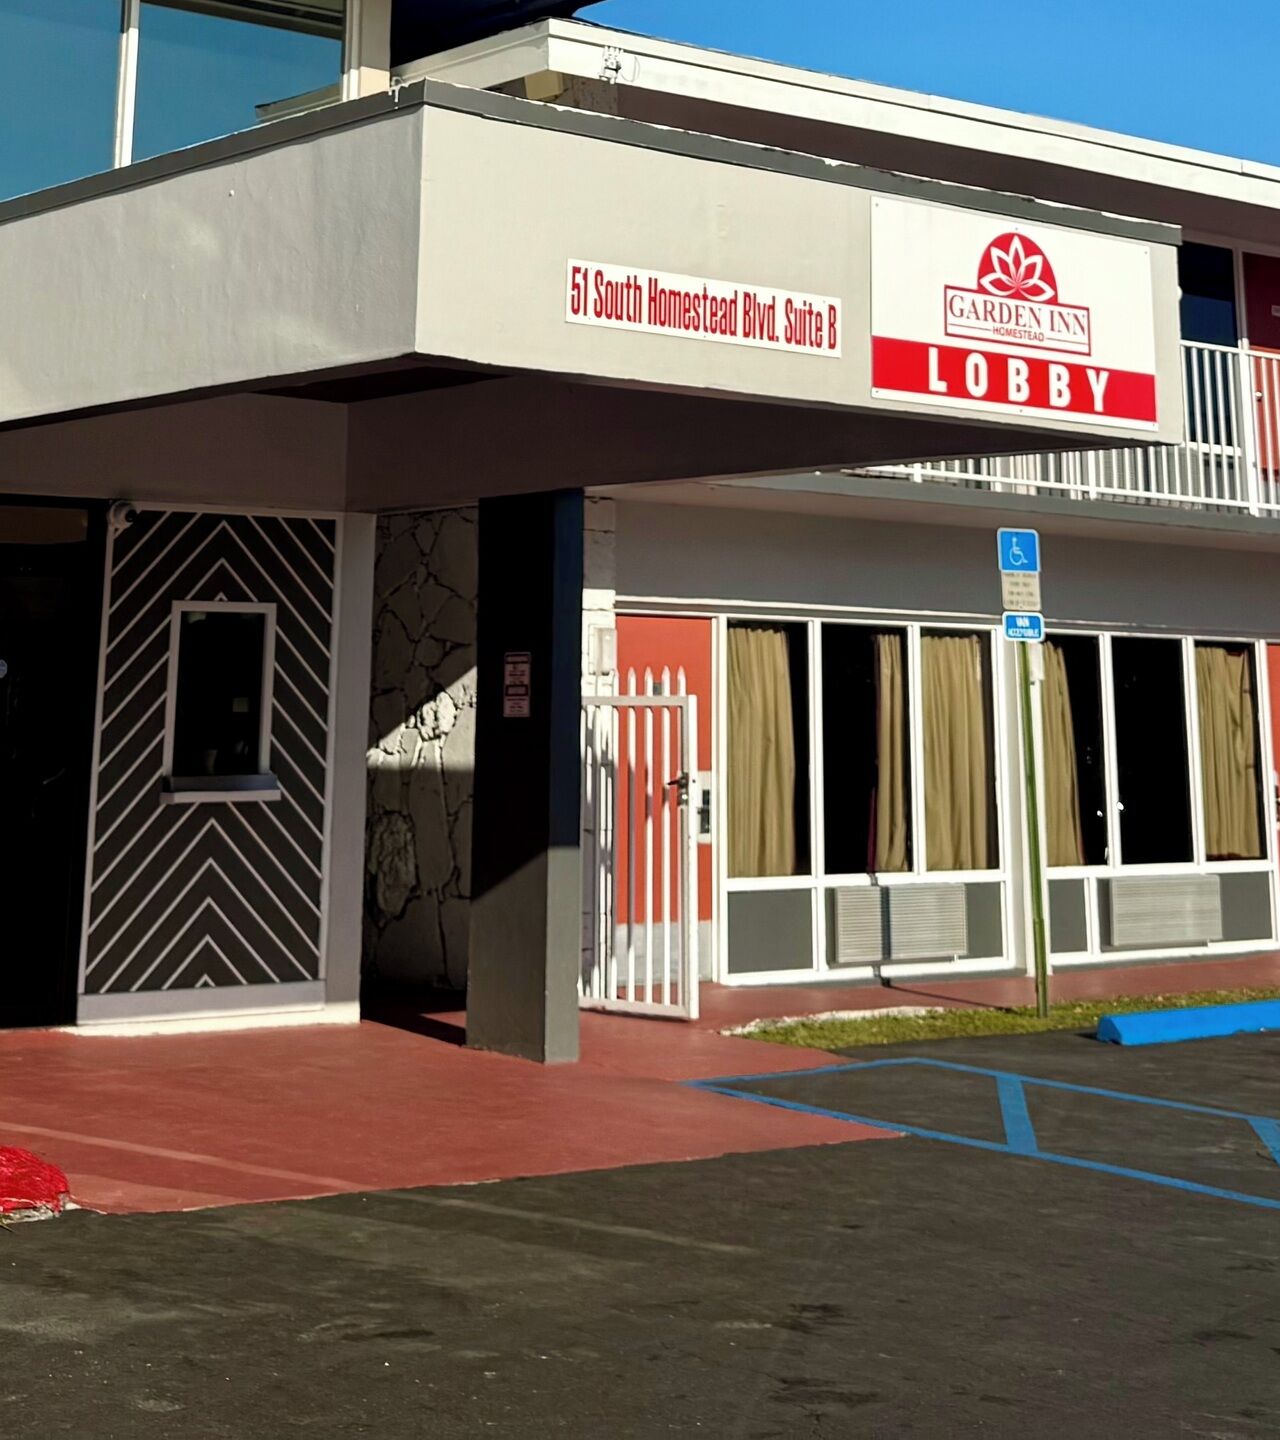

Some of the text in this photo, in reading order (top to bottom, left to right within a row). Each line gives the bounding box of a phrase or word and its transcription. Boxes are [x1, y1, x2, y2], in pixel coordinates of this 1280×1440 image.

[571, 266, 837, 350] 51 South Homestead Blvd. Suite B
[949, 294, 1086, 336] GARDEN INN
[992, 325, 1045, 342] HOMESTEAD
[928, 347, 1110, 412] LOBBY
